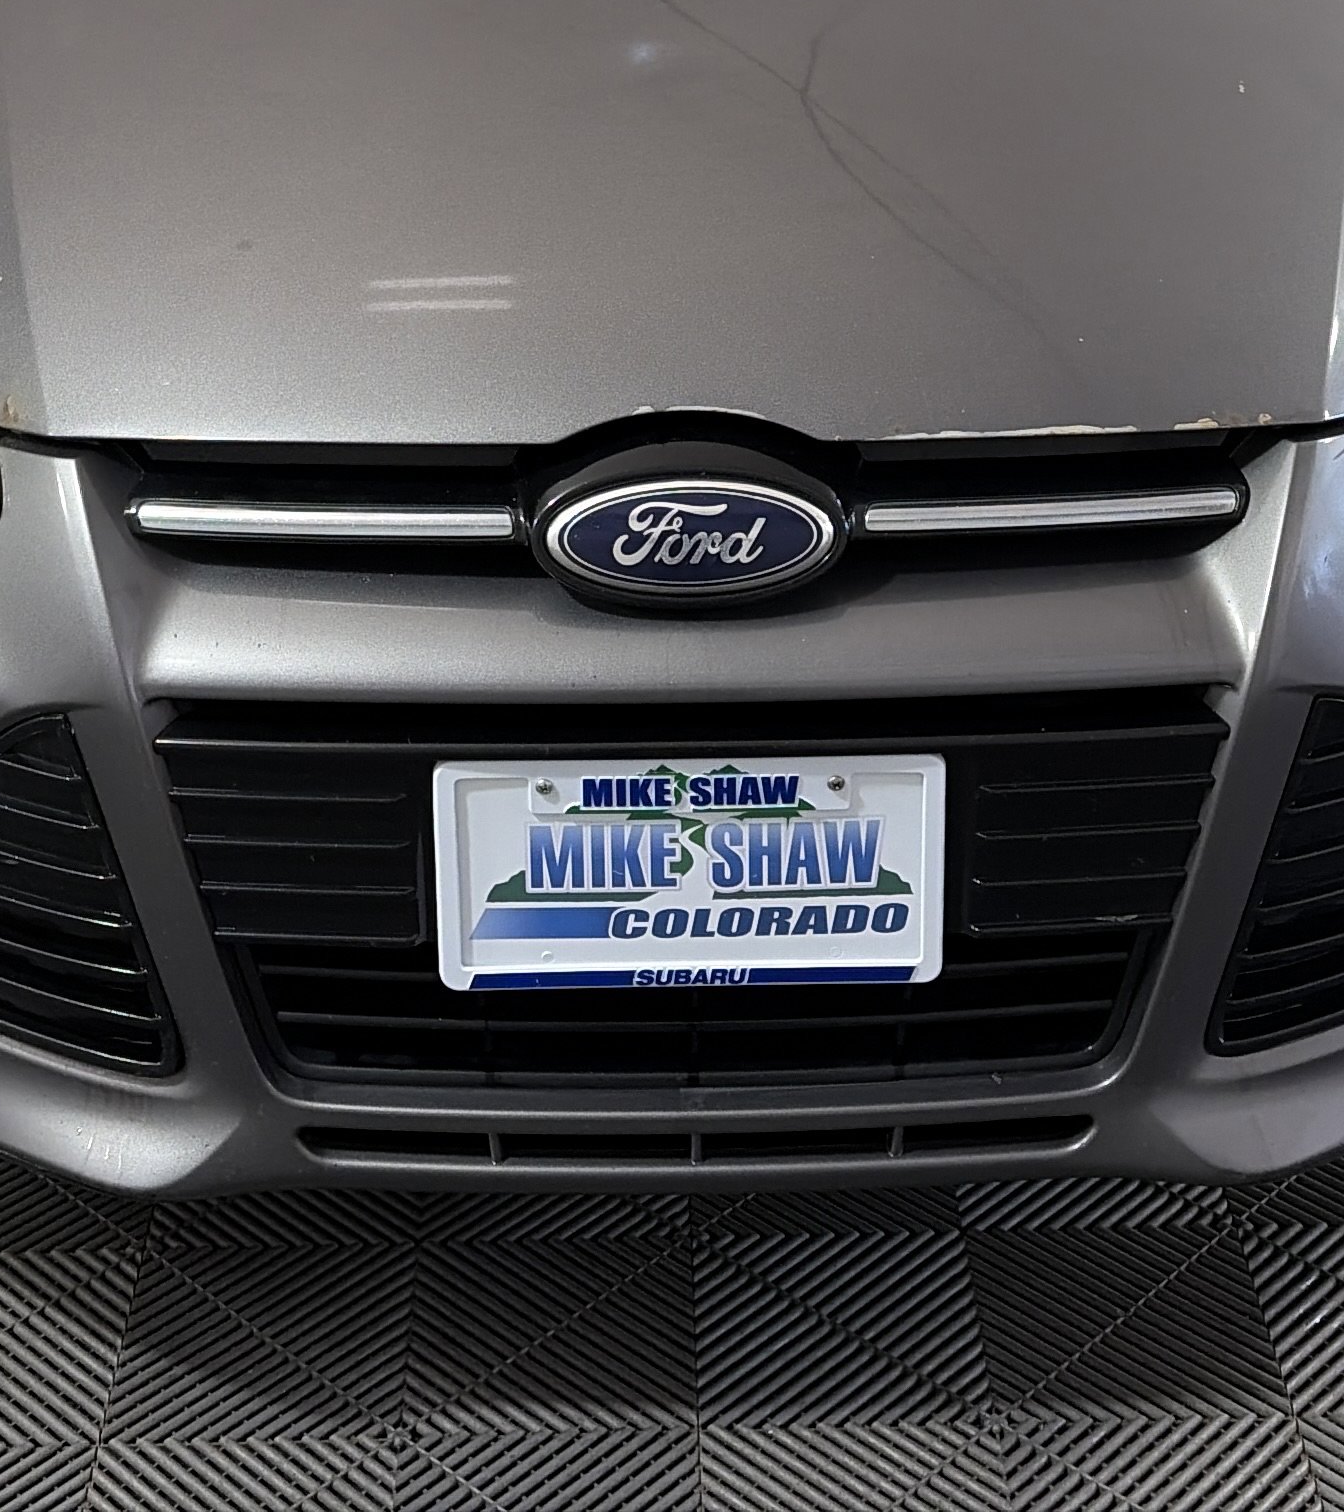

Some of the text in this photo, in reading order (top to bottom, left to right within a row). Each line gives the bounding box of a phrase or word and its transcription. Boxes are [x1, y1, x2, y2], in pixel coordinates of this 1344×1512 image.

[612, 502, 767, 566] Ford
[582, 775, 799, 808] MIKE SHAW
[530, 819, 881, 889] MIKE SHAW
[610, 903, 910, 939] COLORADO
[636, 968, 747, 986] SUBARU
